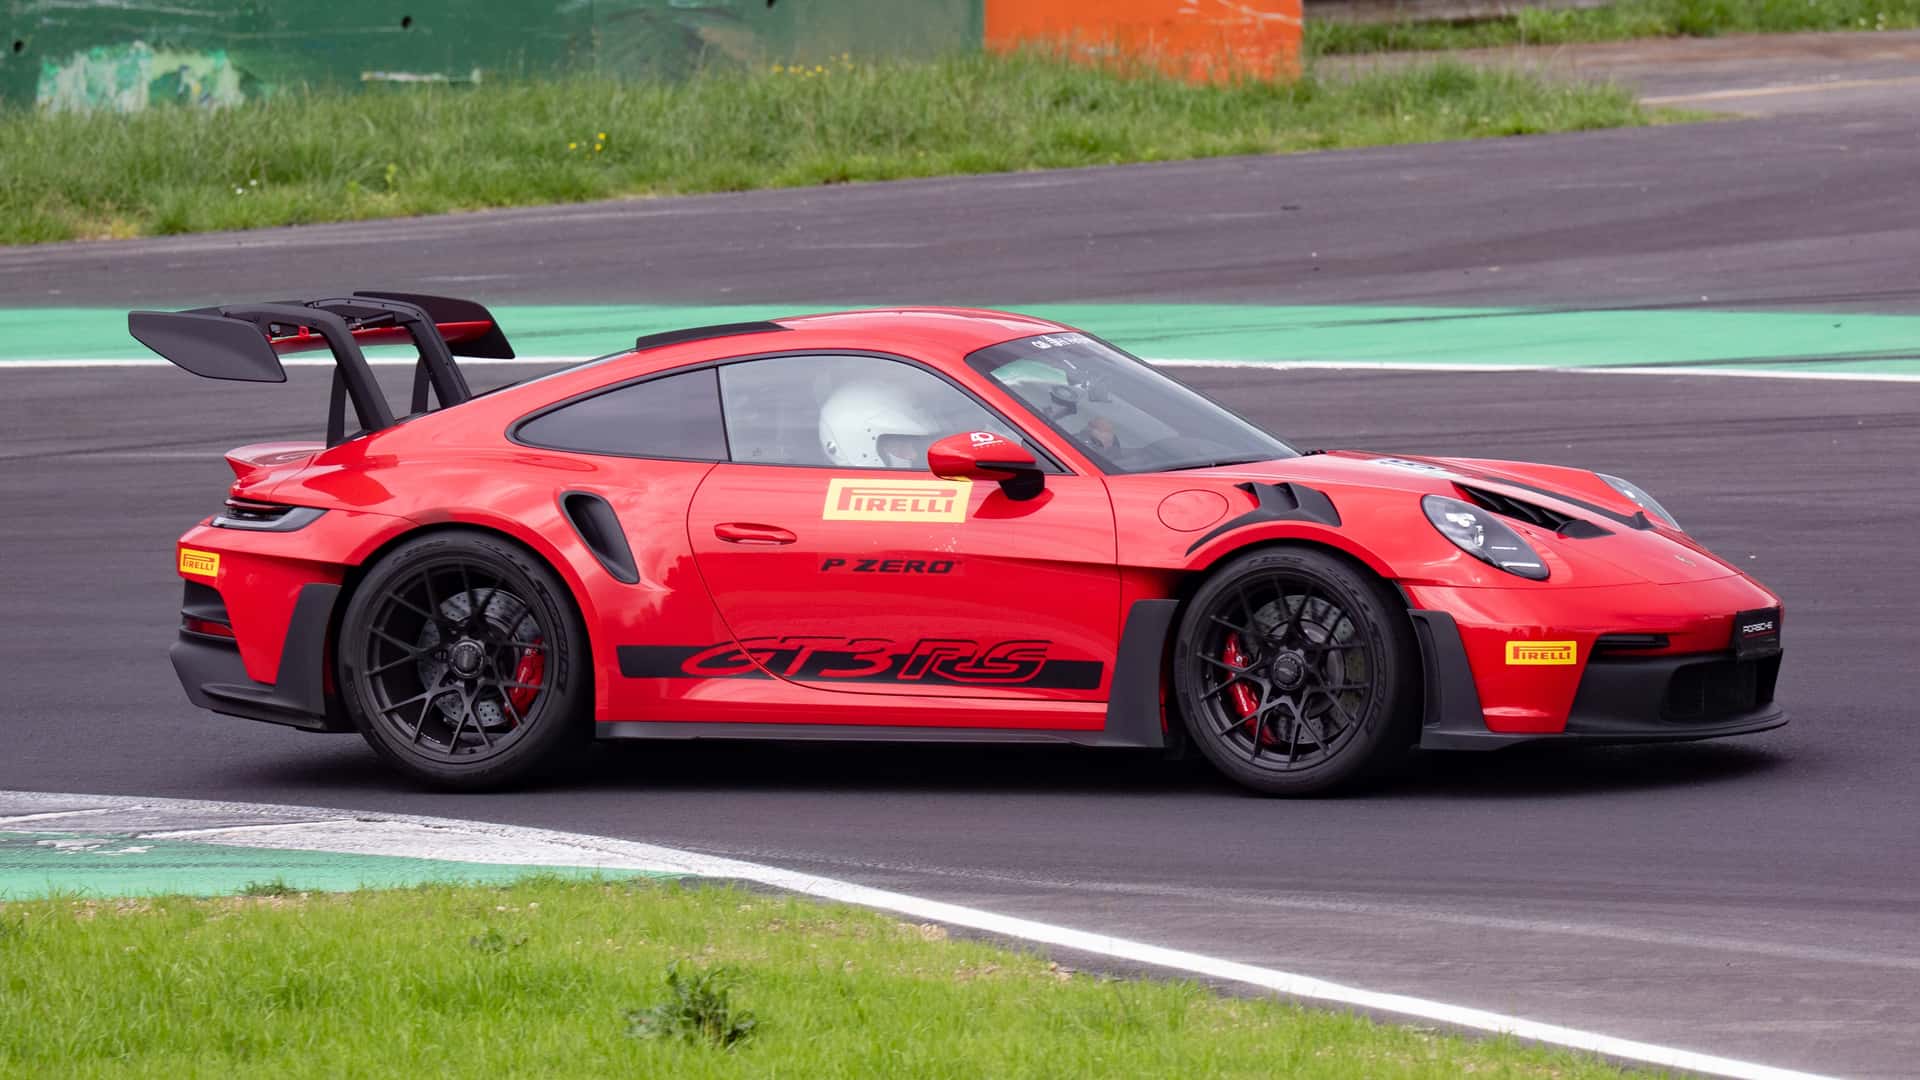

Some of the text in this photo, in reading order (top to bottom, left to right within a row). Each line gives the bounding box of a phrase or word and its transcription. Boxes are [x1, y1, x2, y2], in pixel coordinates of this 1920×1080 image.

[837, 487, 957, 513] PIRELLI
[183, 553, 216, 571] PIRELLI
[820, 558, 955, 574] P ZERO
[1513, 646, 1571, 660] PIRELLI
